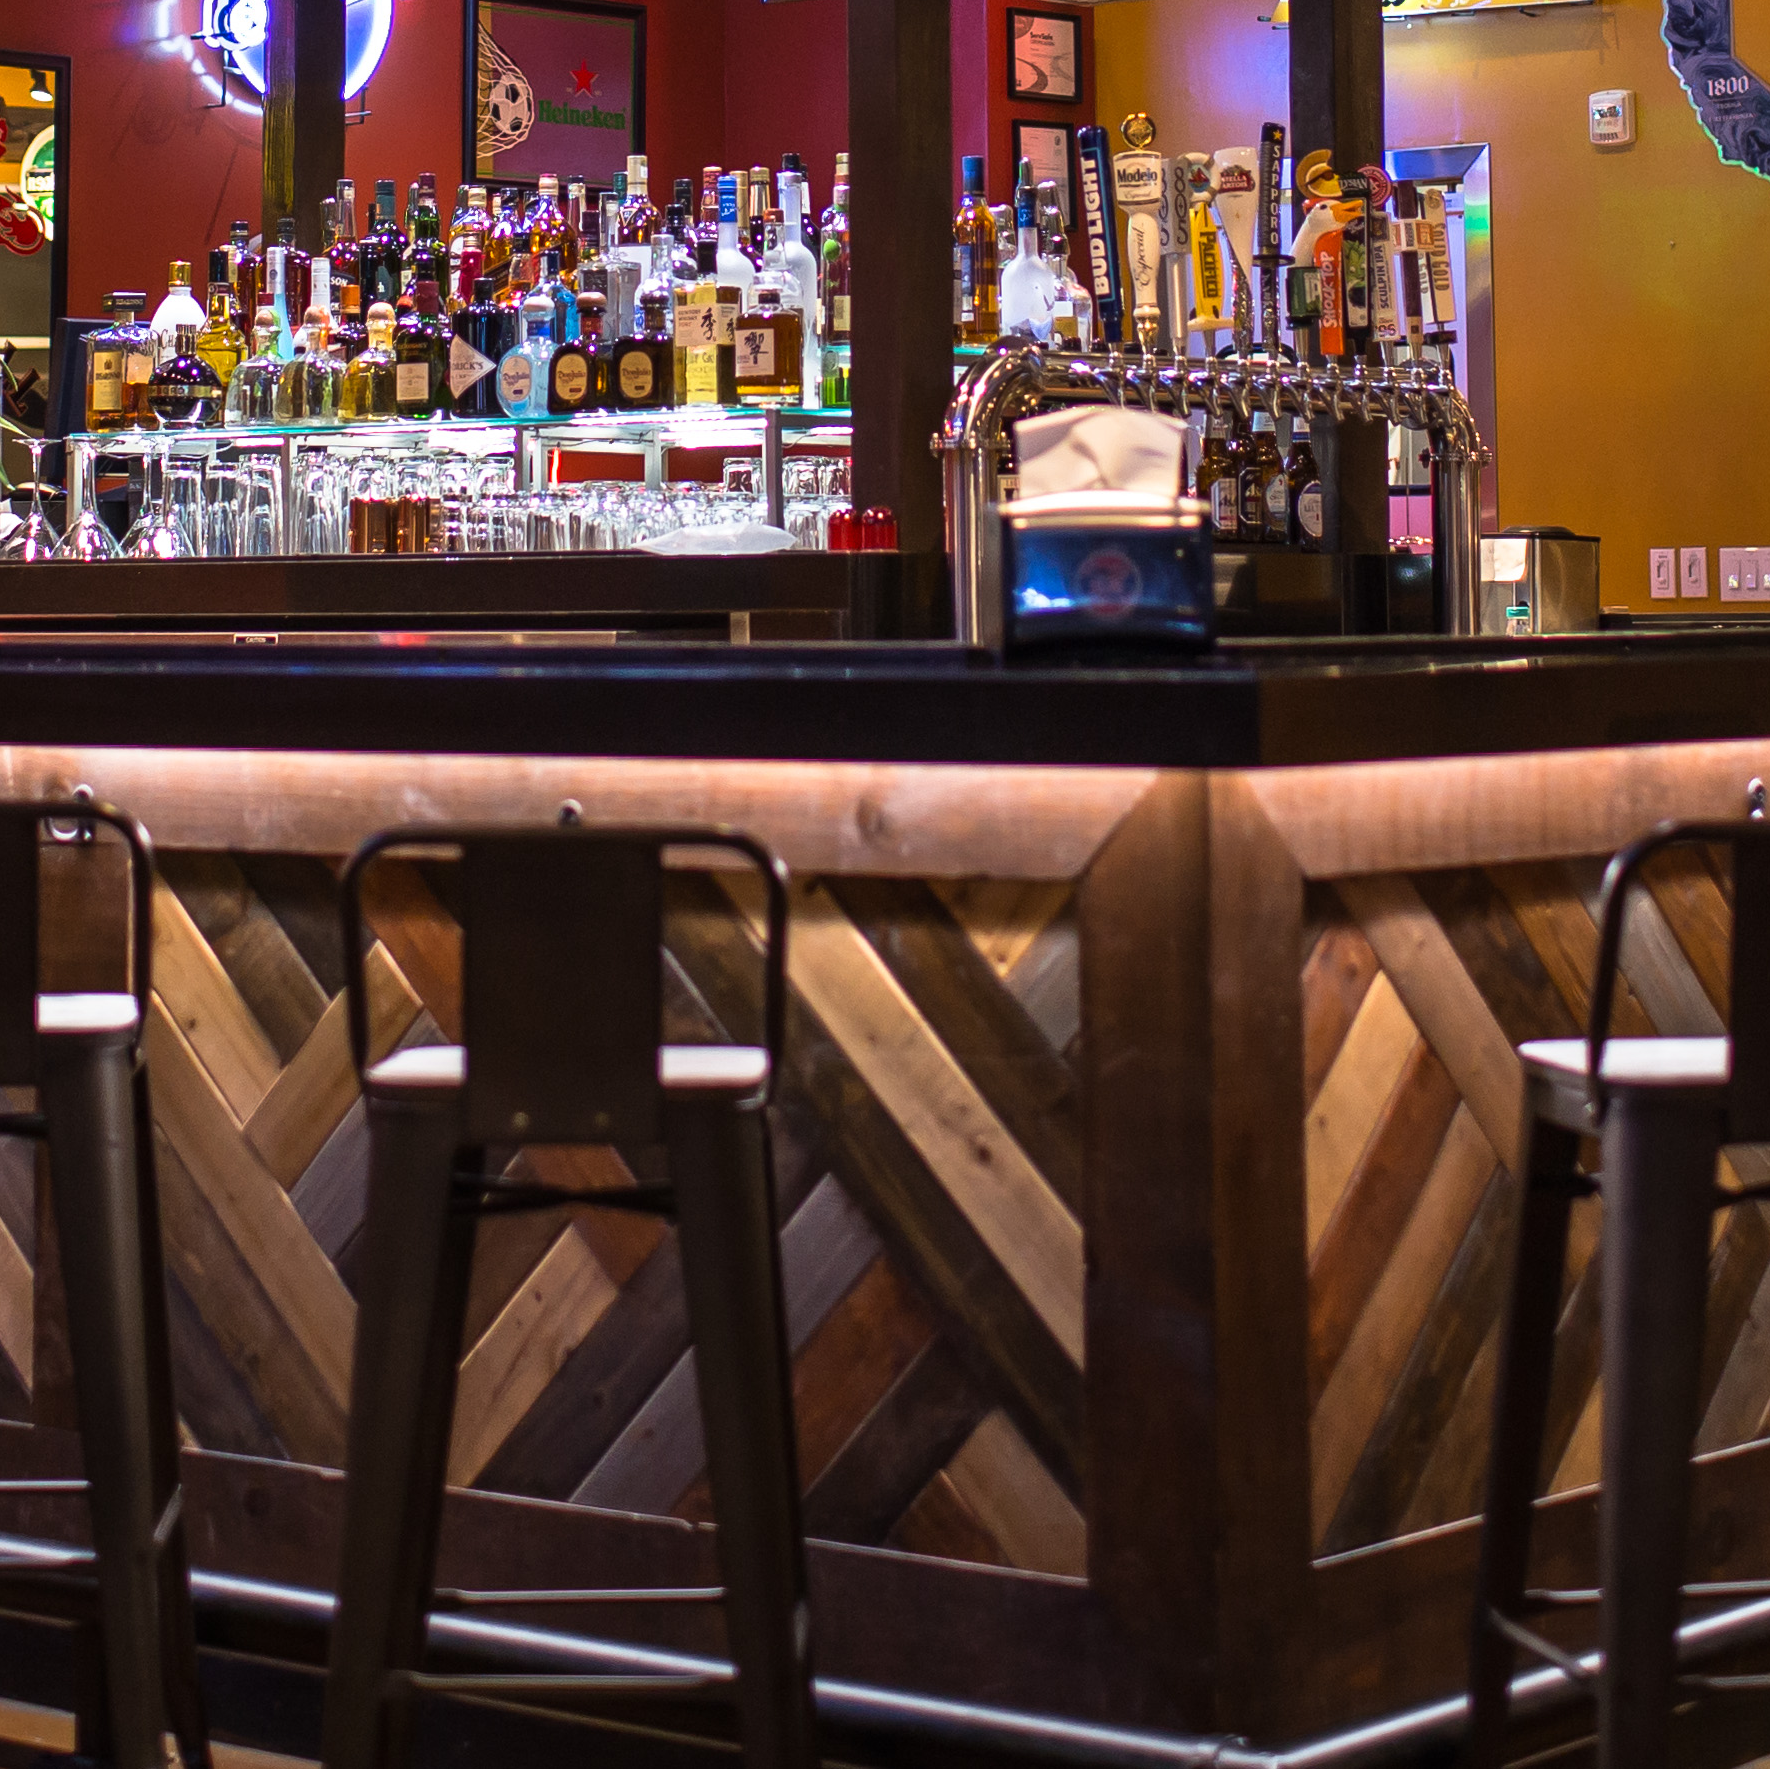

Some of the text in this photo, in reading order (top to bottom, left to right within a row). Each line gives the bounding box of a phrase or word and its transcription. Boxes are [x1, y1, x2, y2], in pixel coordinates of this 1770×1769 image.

[1706, 76, 1749, 96] 1800
[538, 100, 626, 129] Heineken
[1117, 167, 1158, 184] Modelo
[1221, 175, 1247, 184] STELLA
[1221, 181, 1248, 191] ARTOIS
[1340, 177, 1367, 191] LYSIAN
[1270, 145, 1281, 245] SAPPORO
[1081, 156, 1111, 296] BUD LIGHT
[1131, 221, 1154, 292] Especial
[1199, 231, 1218, 298] PACIFICO
[1319, 250, 1338, 328] SHOCK TOP
[1373, 244, 1389, 309] SCULPIN IPA
[1433, 260, 1450, 292] GOLD
